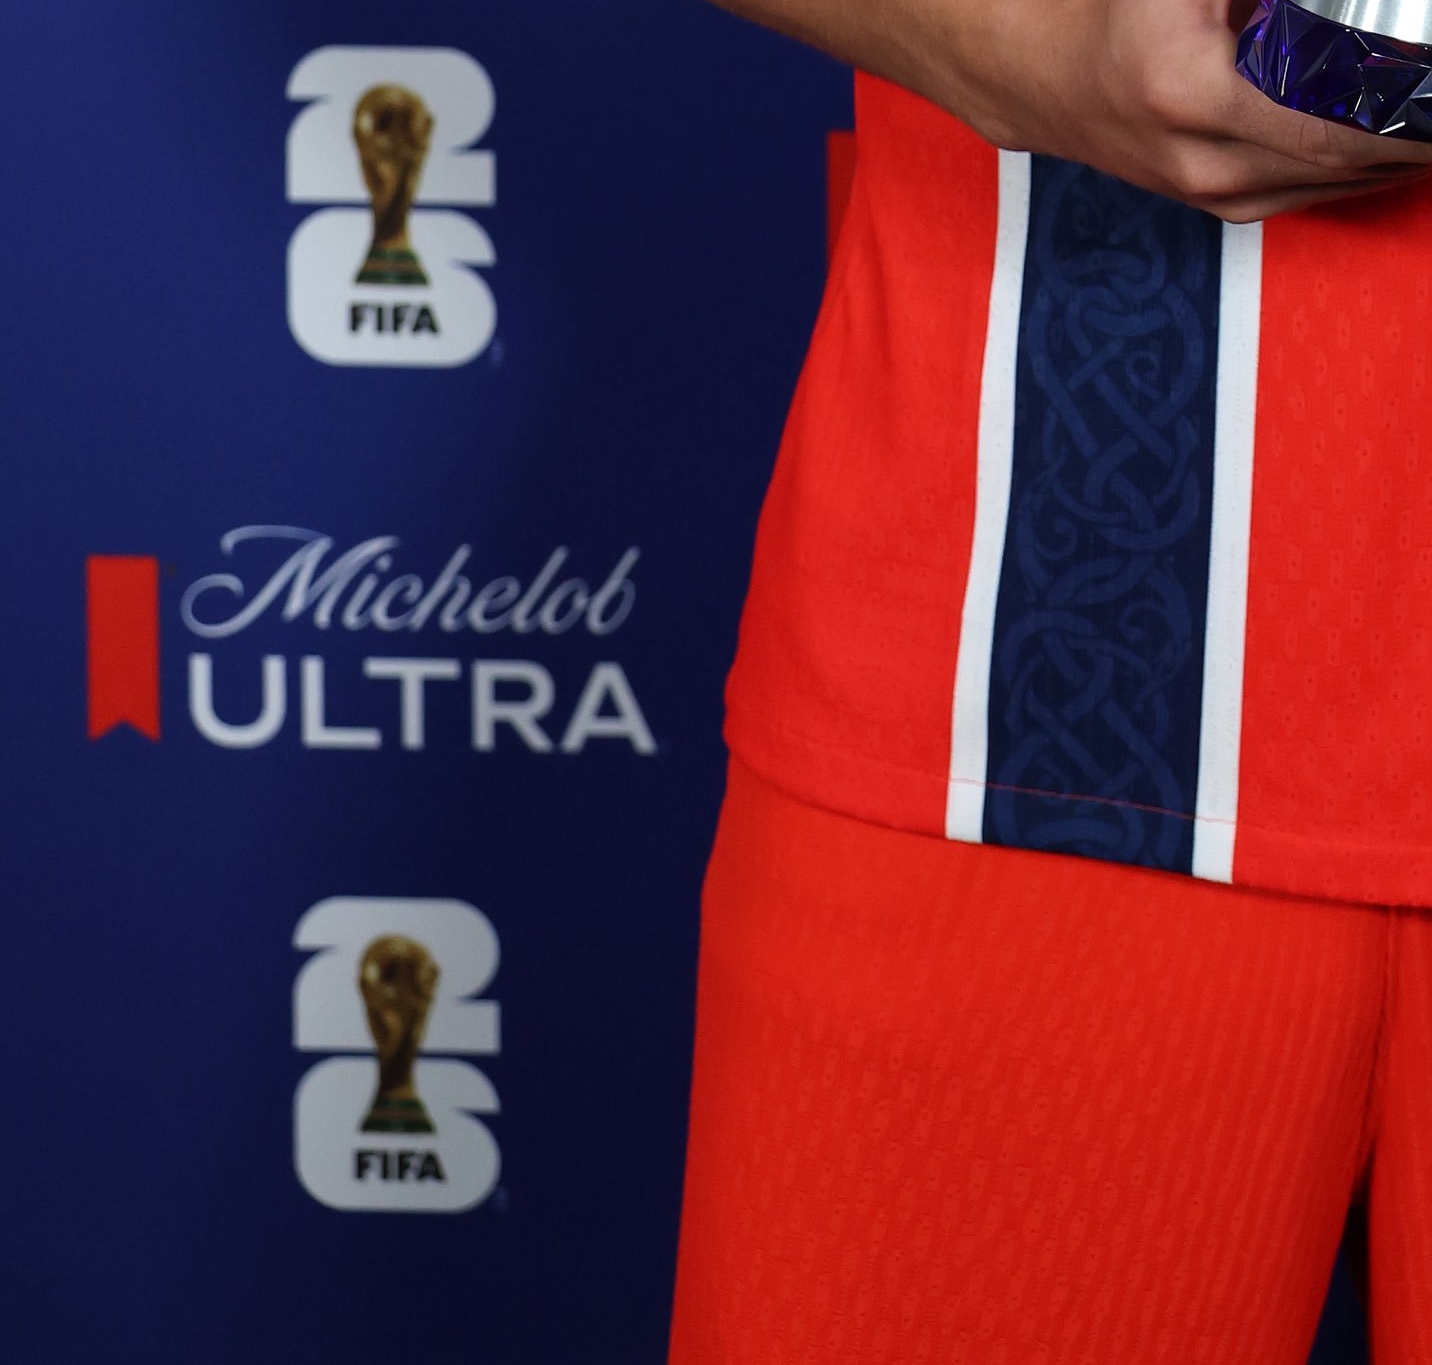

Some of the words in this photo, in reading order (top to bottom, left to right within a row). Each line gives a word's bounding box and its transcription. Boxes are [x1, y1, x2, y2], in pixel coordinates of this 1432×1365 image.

[348, 302, 440, 336] FIFA
[181, 525, 639, 639] Michelob
[188, 653, 656, 754] ULTRA
[354, 1149, 446, 1184] FIFA
